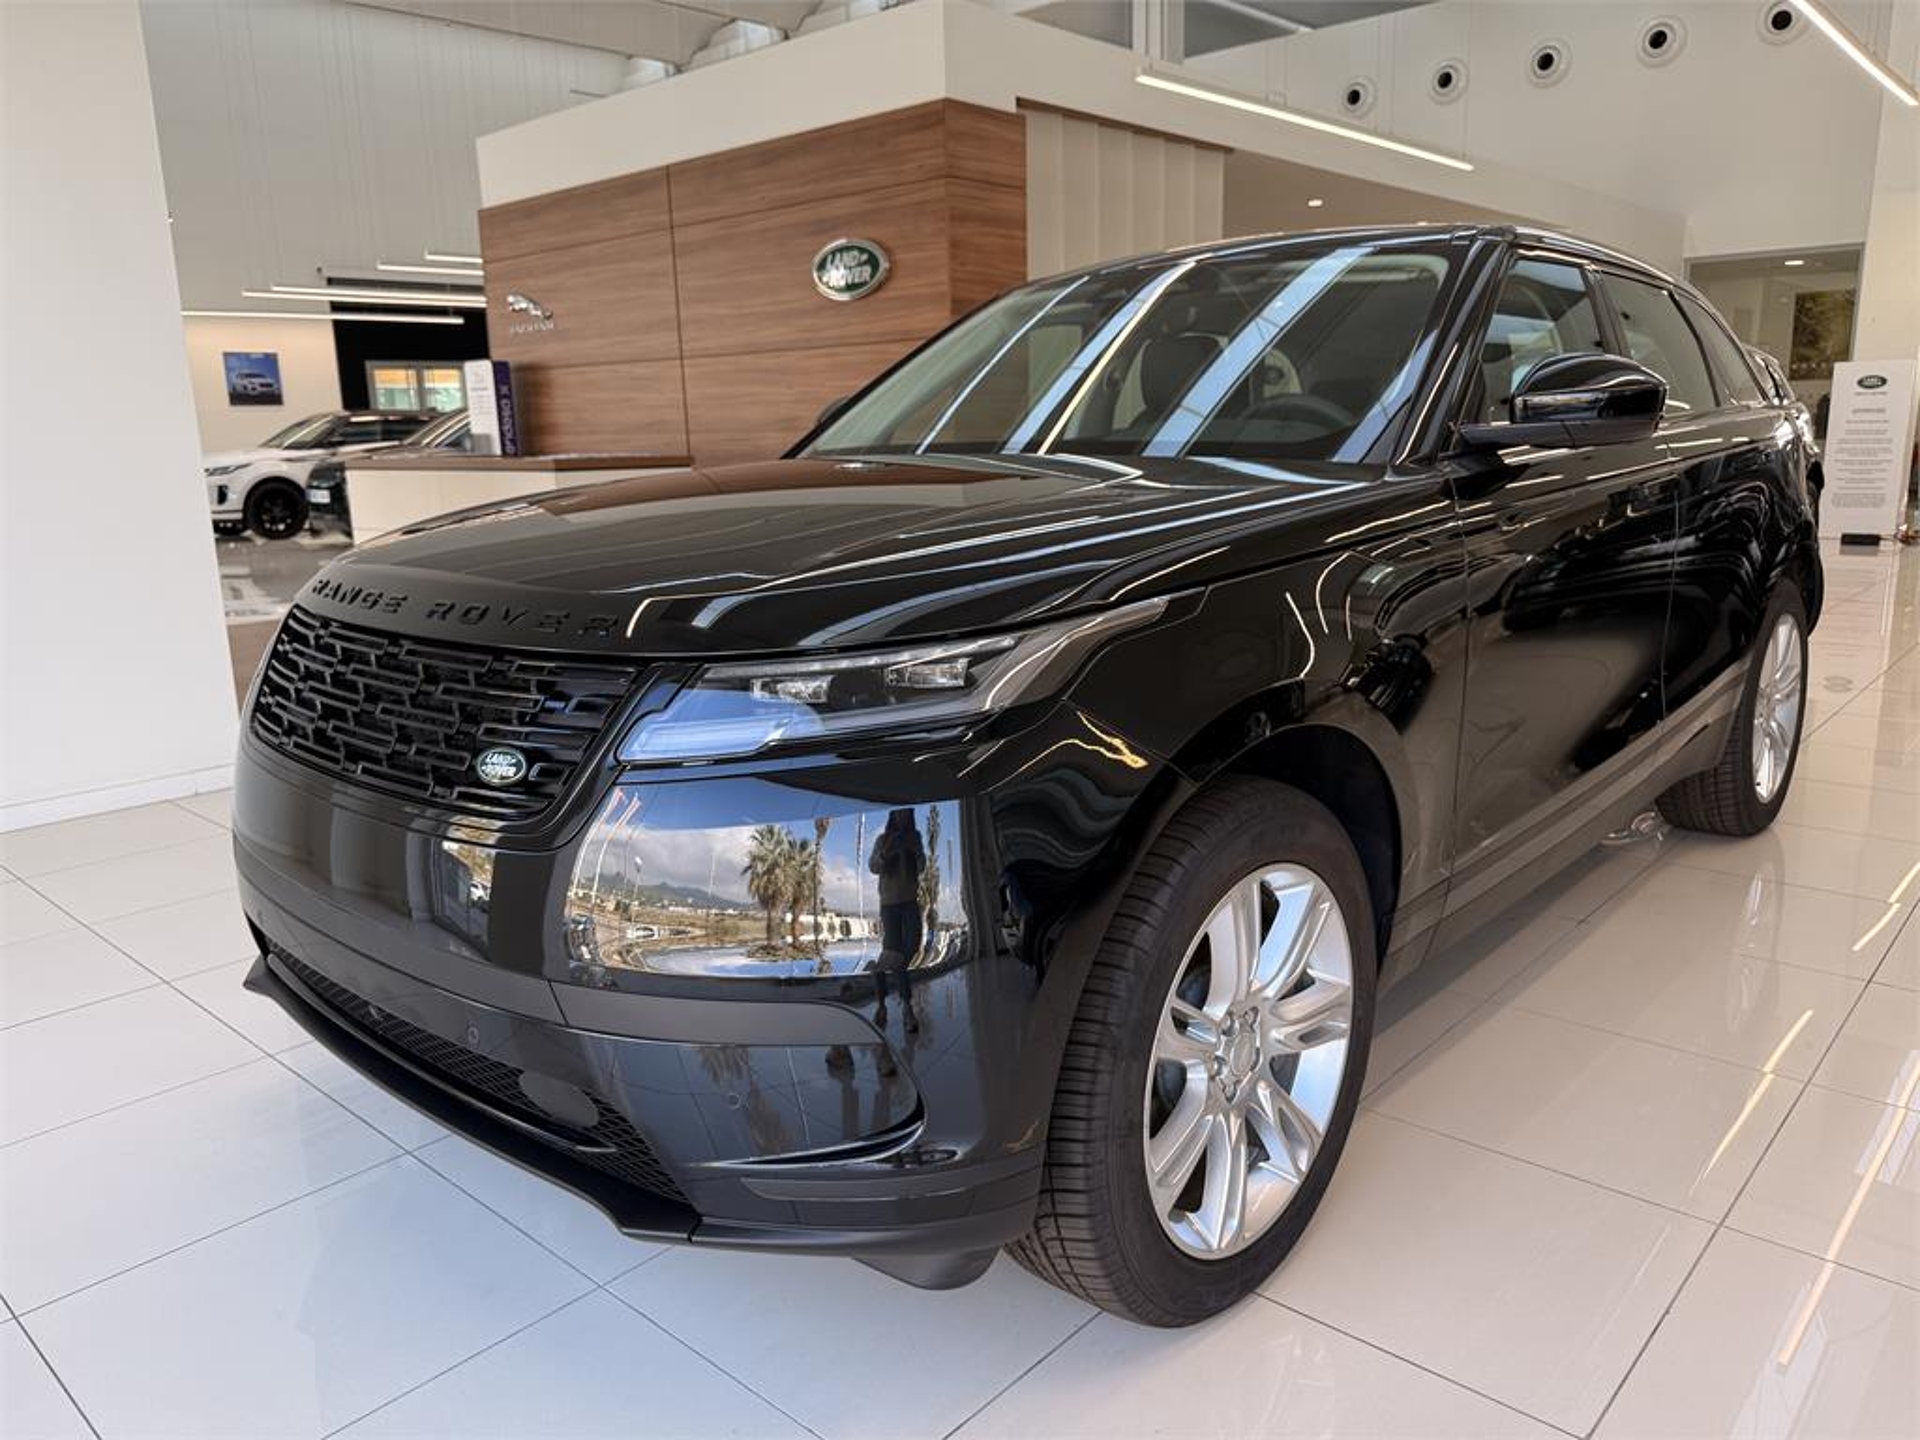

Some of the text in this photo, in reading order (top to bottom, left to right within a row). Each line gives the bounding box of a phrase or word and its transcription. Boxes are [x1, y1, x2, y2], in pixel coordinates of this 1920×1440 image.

[825, 249, 860, 271] LAND
[828, 265, 872, 287] ROVER
[312, 579, 619, 637] RANGE ROVER
